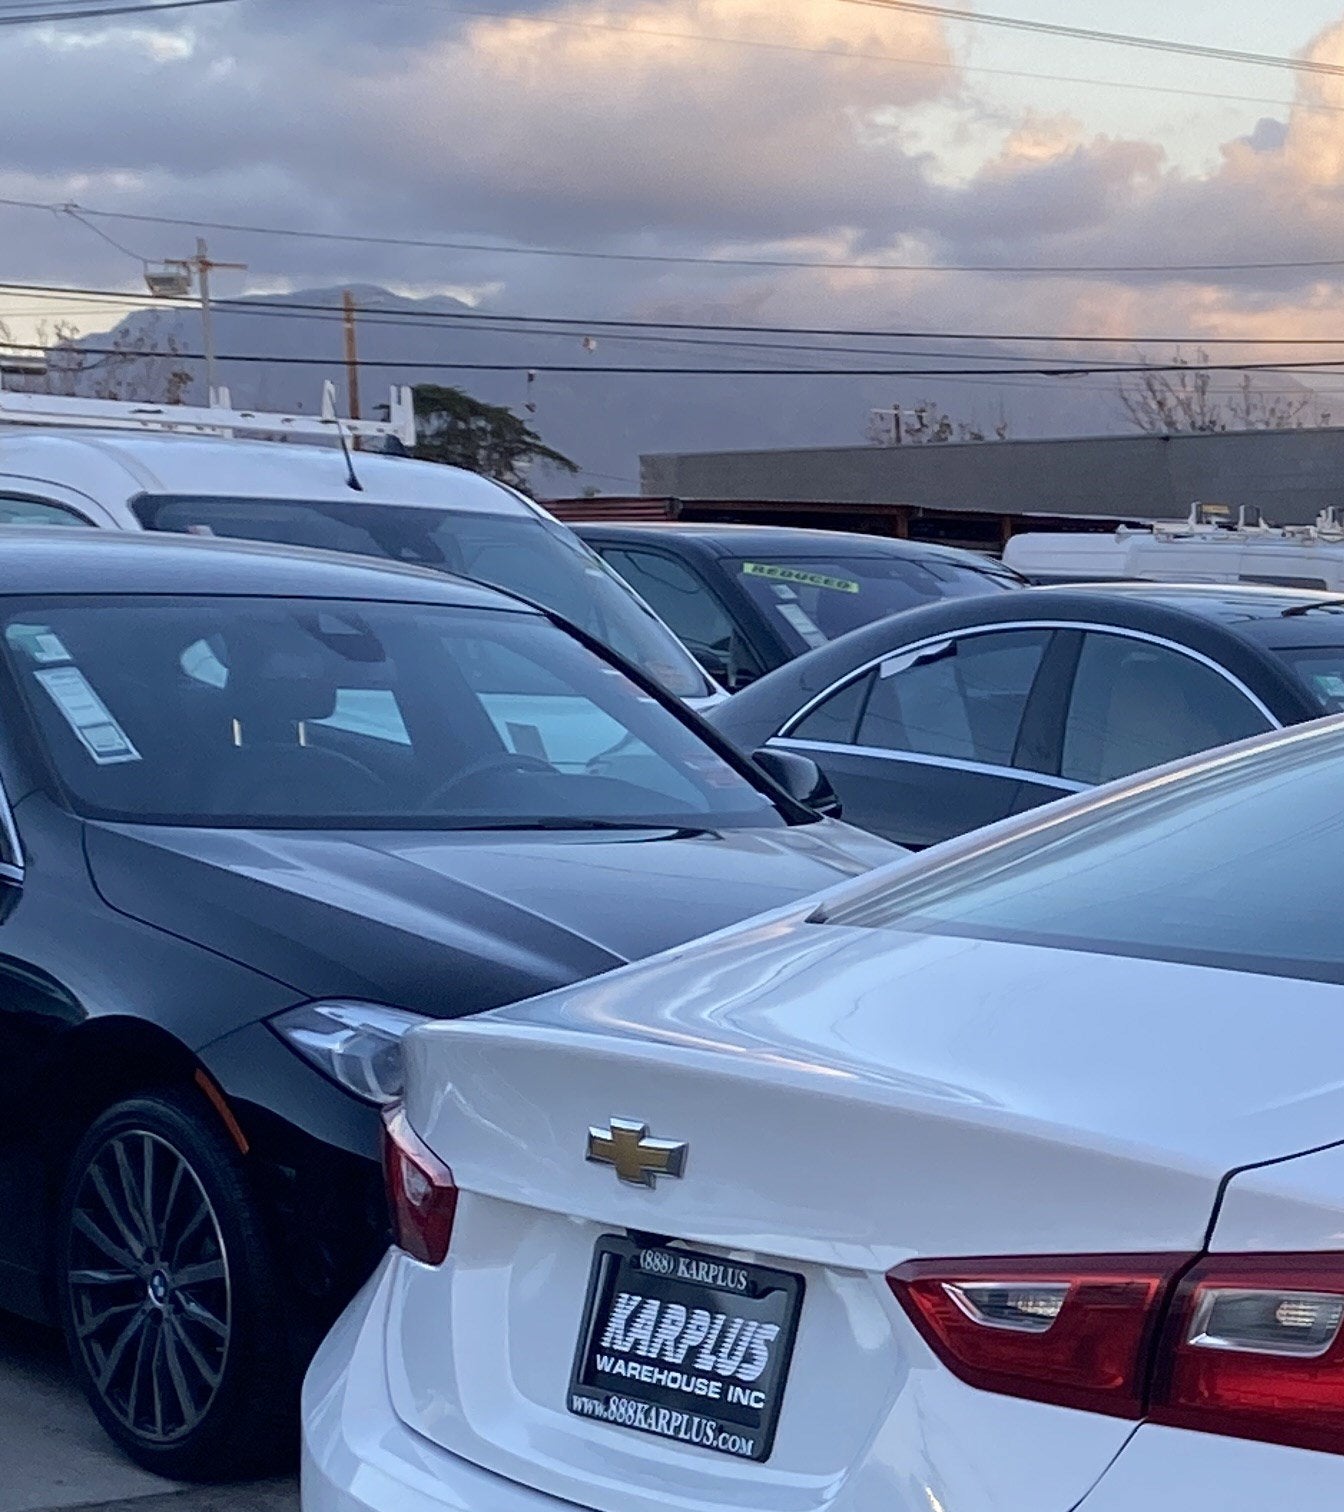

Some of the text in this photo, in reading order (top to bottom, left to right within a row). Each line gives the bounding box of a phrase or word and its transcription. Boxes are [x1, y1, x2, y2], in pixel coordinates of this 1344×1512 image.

[751, 564, 851, 590] REDUCED
[639, 1249, 749, 1291] (888) KARPLUS
[600, 1292, 780, 1382] KARPLUS
[596, 1353, 766, 1409] WAREHOUSE INC
